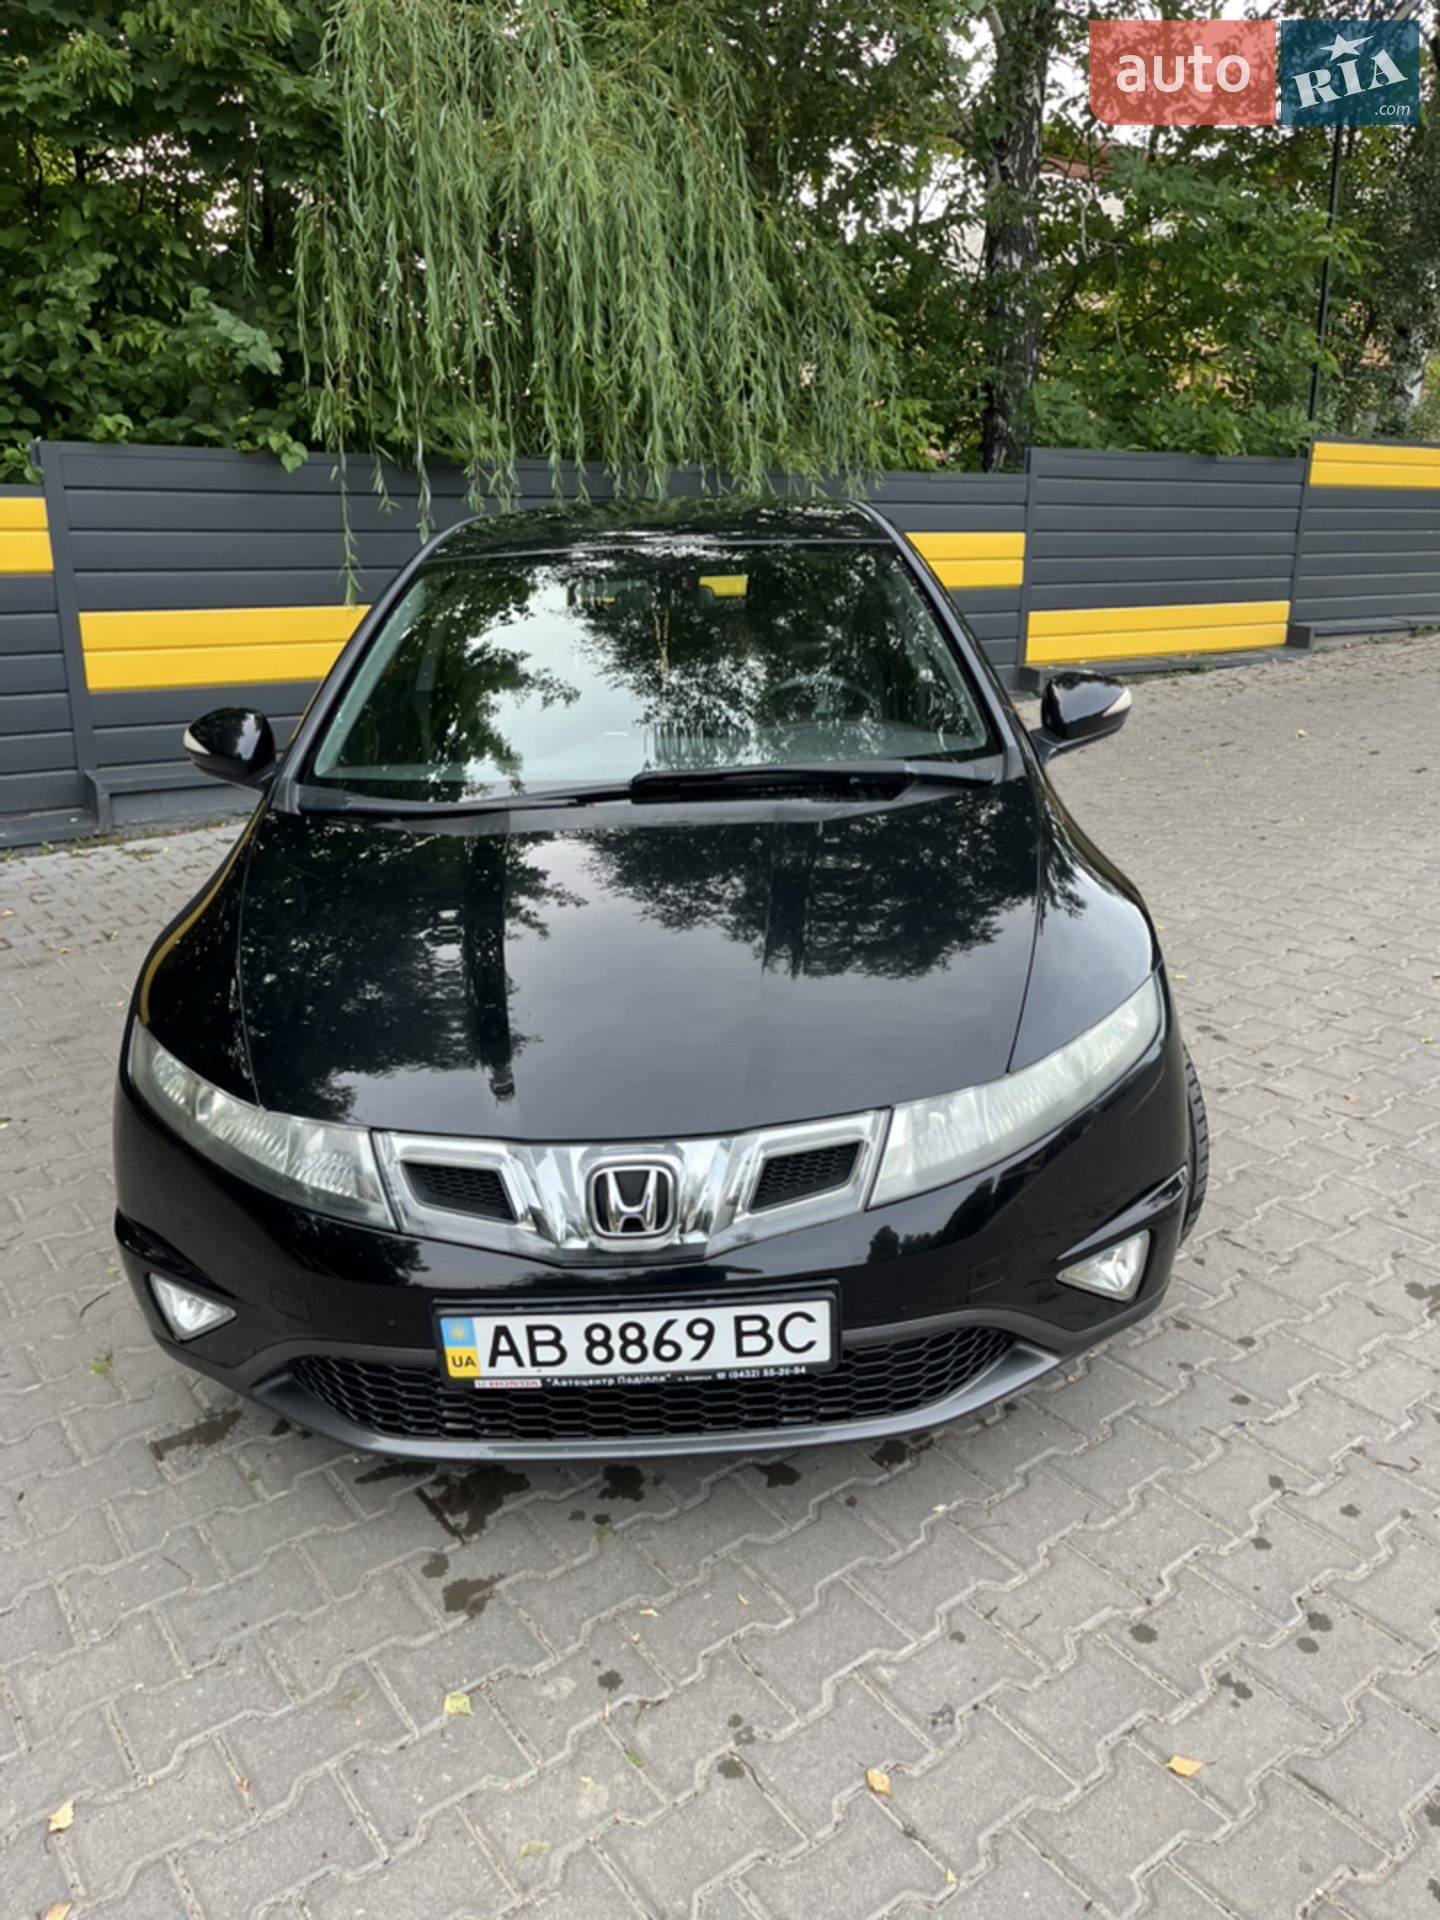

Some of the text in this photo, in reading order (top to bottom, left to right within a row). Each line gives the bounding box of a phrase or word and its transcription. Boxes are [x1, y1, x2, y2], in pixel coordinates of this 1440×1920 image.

[488, 1311, 817, 1368] AB 8869 BC
[451, 1355, 476, 1369] UA
